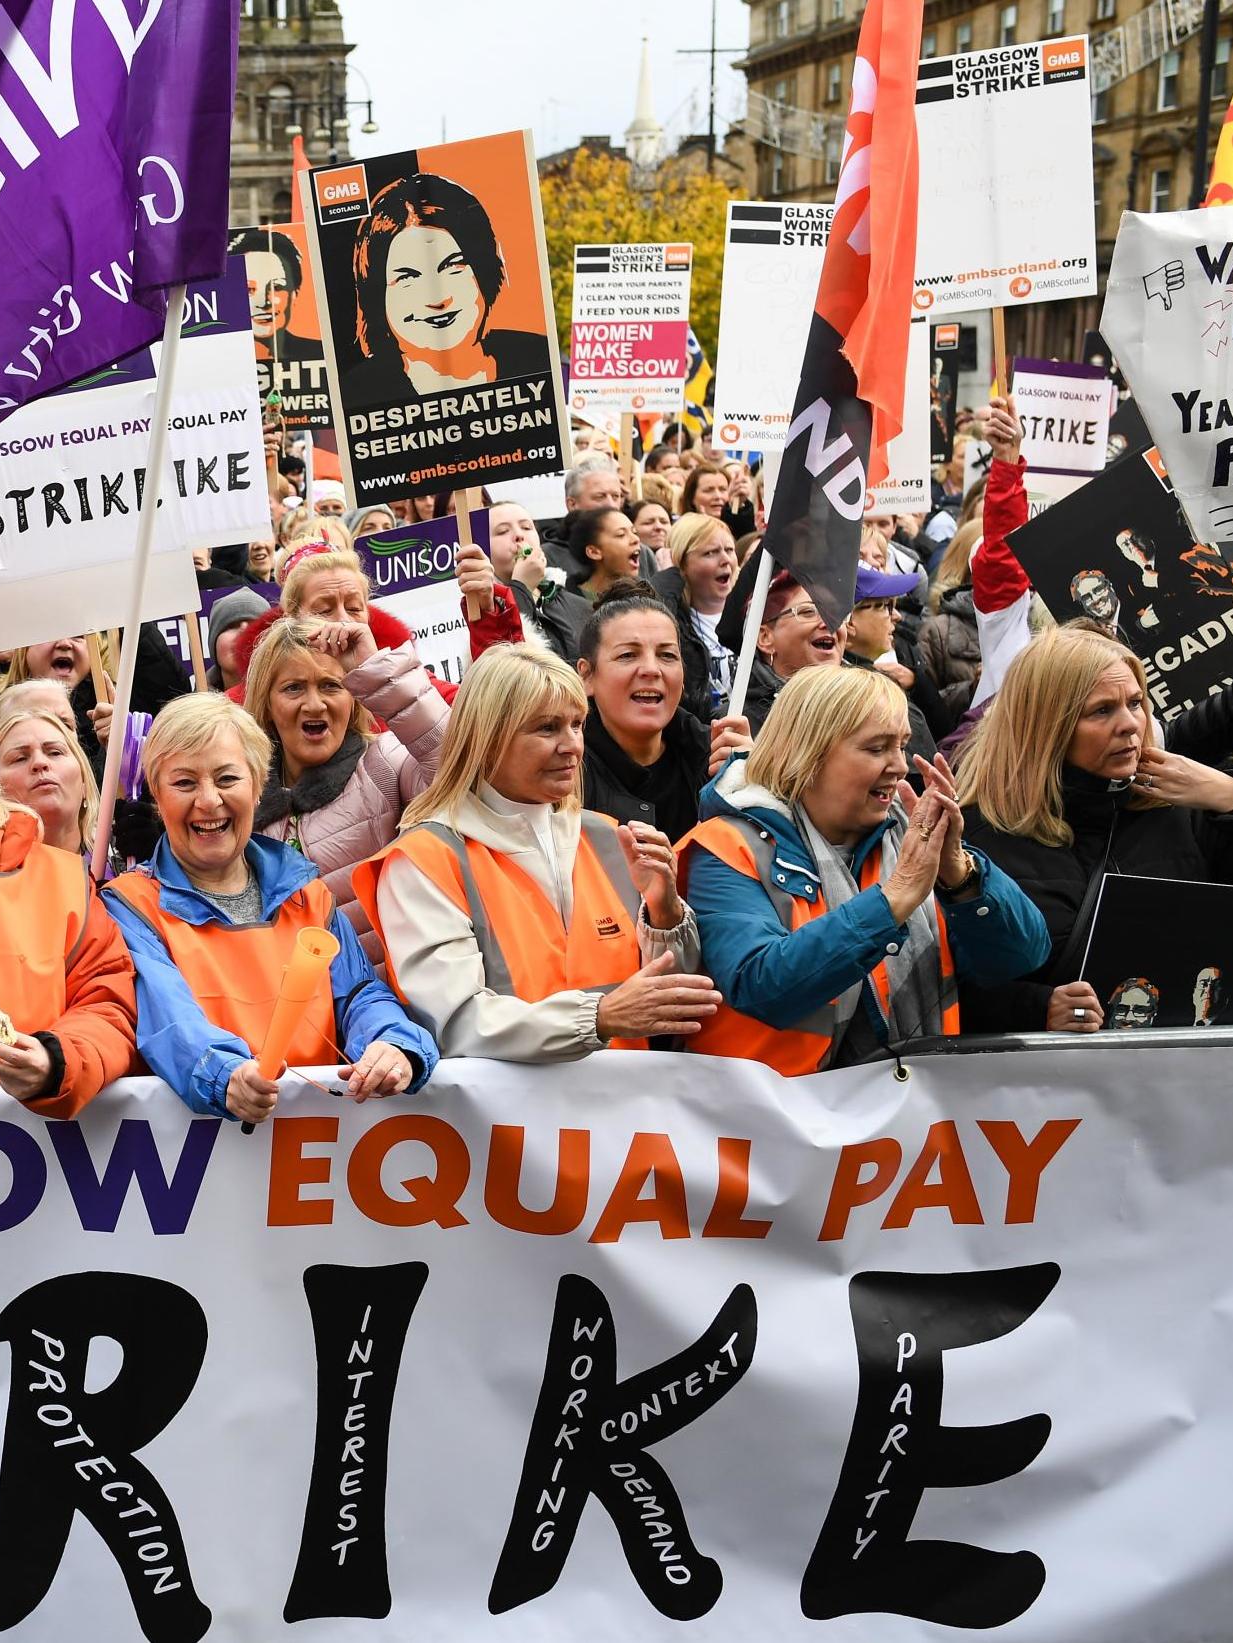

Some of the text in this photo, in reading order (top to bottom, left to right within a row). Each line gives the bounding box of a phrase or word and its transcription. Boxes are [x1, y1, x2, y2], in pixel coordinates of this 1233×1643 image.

[955, 46, 1039, 69] GLASGOW
[1047, 52, 1081, 67] GMB
[956, 59, 1040, 83] WOMEN'S
[1049, 70, 1079, 79] SCOTLAND
[956, 72, 1041, 99] STRIKE
[323, 182, 361, 200] GMB
[328, 204, 361, 216] SCOTLAND
[612, 246, 664, 254] GLASGOW
[612, 254, 664, 263] WOMEN'S
[611, 263, 664, 273] STRIKE
[914, 256, 1088, 287] www.gmbscotland.org
[1034, 275, 1090, 291] /GMBScotland
[936, 288, 992, 302] @GMBScotOrg
[587, 308, 615, 316] FEED
[619, 307, 650, 315] YOUR
[654, 306, 680, 314] KIDS
[574, 324, 654, 342] WOMEN
[575, 342, 634, 359] MAKE
[574, 359, 680, 377] GLASGOW
[1018, 387, 1101, 402] GLASGOW EQUAL PAY
[220, 409, 248, 424] PAY
[348, 380, 547, 435] DESPERATELY
[61, 424, 117, 446] EQUAL
[121, 418, 152, 436] PAY
[354, 407, 552, 460] SEEKING SUSAN
[360, 445, 557, 490] www.gmbscotland.org
[267, 1114, 773, 1243] EQUAL
[818, 1118, 1083, 1242] PAY
[600, 1332, 739, 1442] CONTEXT
[331, 1305, 373, 1566] INTEREST
[532, 1317, 603, 1552] WORKING
[852, 1332, 916, 1560] PARITY
[29, 1329, 181, 1594] PROTECTION
[609, 1462, 691, 1586] DEMAND
